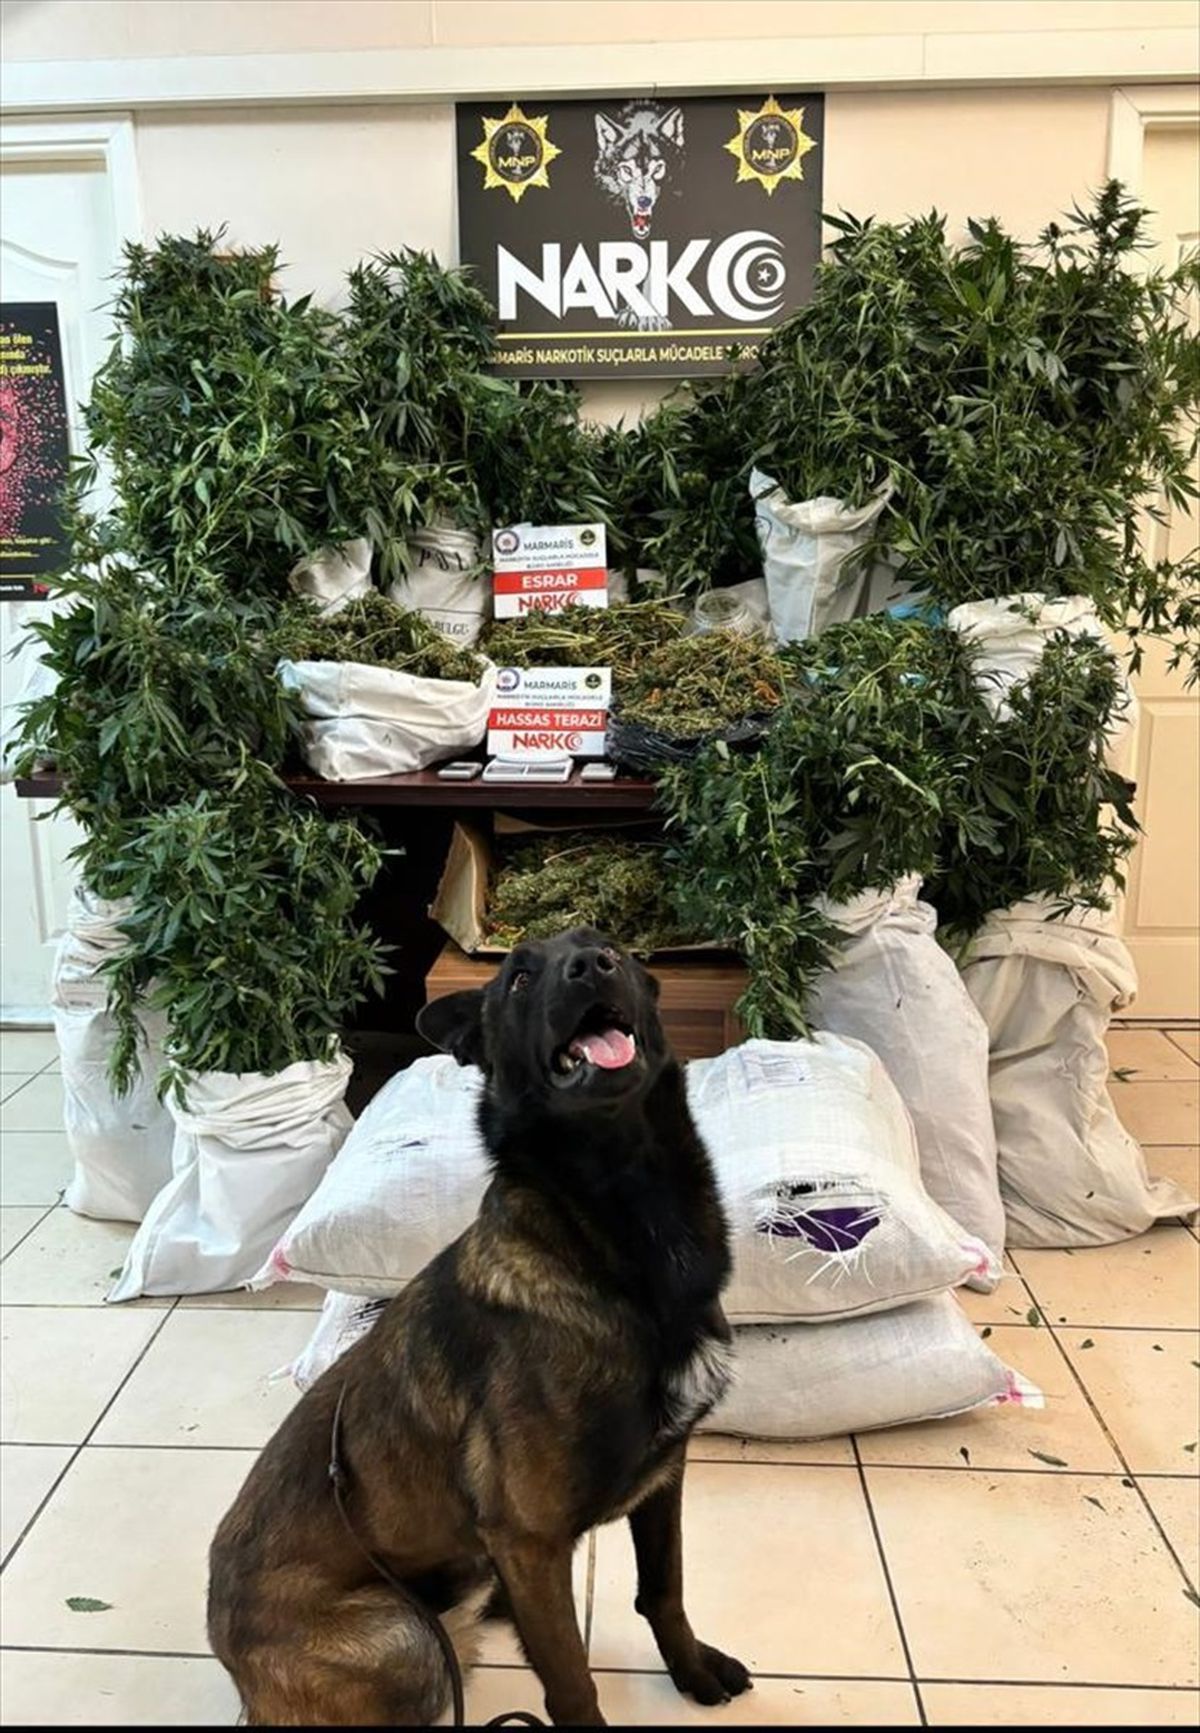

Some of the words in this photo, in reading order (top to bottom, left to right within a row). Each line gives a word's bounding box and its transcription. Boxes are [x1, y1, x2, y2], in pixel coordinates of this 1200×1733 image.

[498, 155, 536, 168] MNP
[752, 148, 790, 161] MNP
[536, 345, 595, 364] NARKOTİK
[597, 347, 657, 366] SUÇLARLA
[659, 344, 723, 362] MÜCADELE
[523, 537, 574, 551] MARMARİS
[522, 573, 578, 589] ESRAR
[523, 679, 578, 691] MARMARİS
[496, 712, 549, 726] HASSAS
[553, 711, 602, 727] TERAZİ
